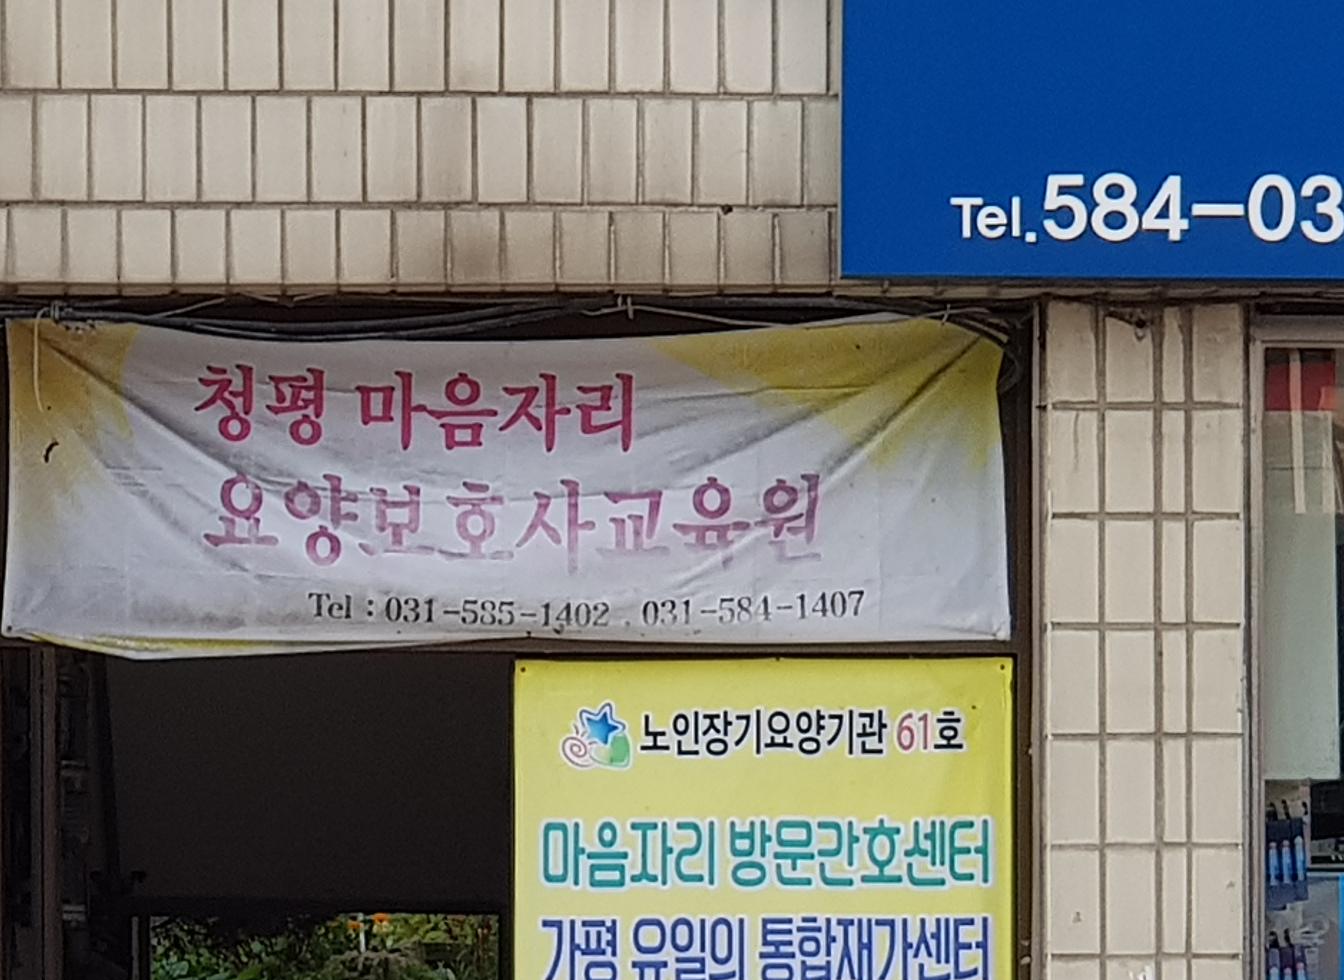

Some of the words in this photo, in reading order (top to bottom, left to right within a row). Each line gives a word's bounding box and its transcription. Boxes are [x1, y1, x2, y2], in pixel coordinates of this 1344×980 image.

[194, 364, 327, 452] 청평
[355, 372, 636, 454] 마음자리
[203, 472, 825, 571] 요양보호사교육원
[384, 595, 611, 628] 031-585-1402
[642, 589, 866, 627] 031-584-1407
[640, 709, 885, 756] 노인장기요양기관
[896, 711, 964, 752] 61호
[541, 820, 716, 887] 마음자리
[729, 819, 991, 887] 방문간호센터
